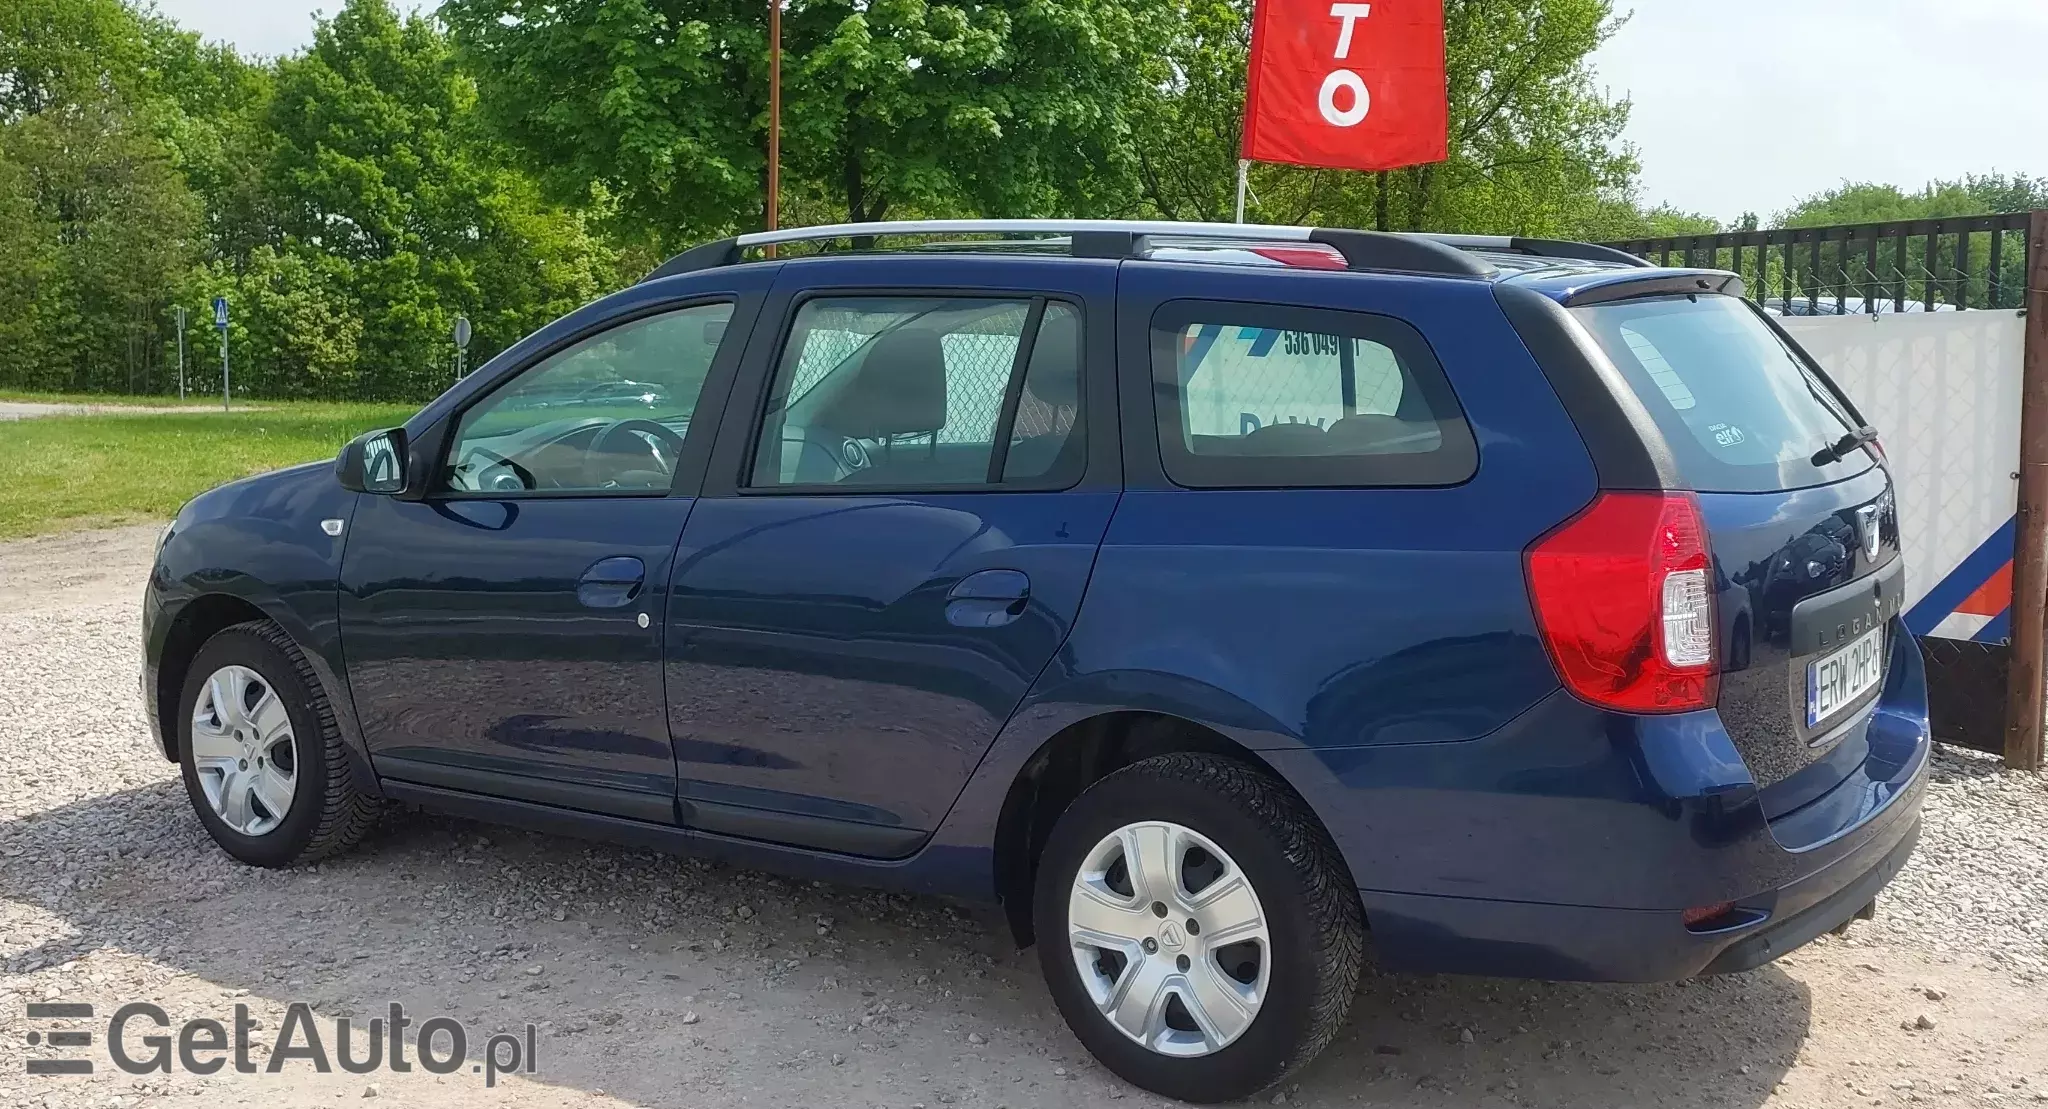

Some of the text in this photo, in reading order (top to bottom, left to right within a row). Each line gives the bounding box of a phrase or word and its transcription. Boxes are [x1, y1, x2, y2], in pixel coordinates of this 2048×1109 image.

[1284, 330, 1309, 355] 536
[1312, 333, 1338, 356] 049
[1819, 605, 1882, 646] LOGAN
[1820, 652, 1848, 712] ERW
